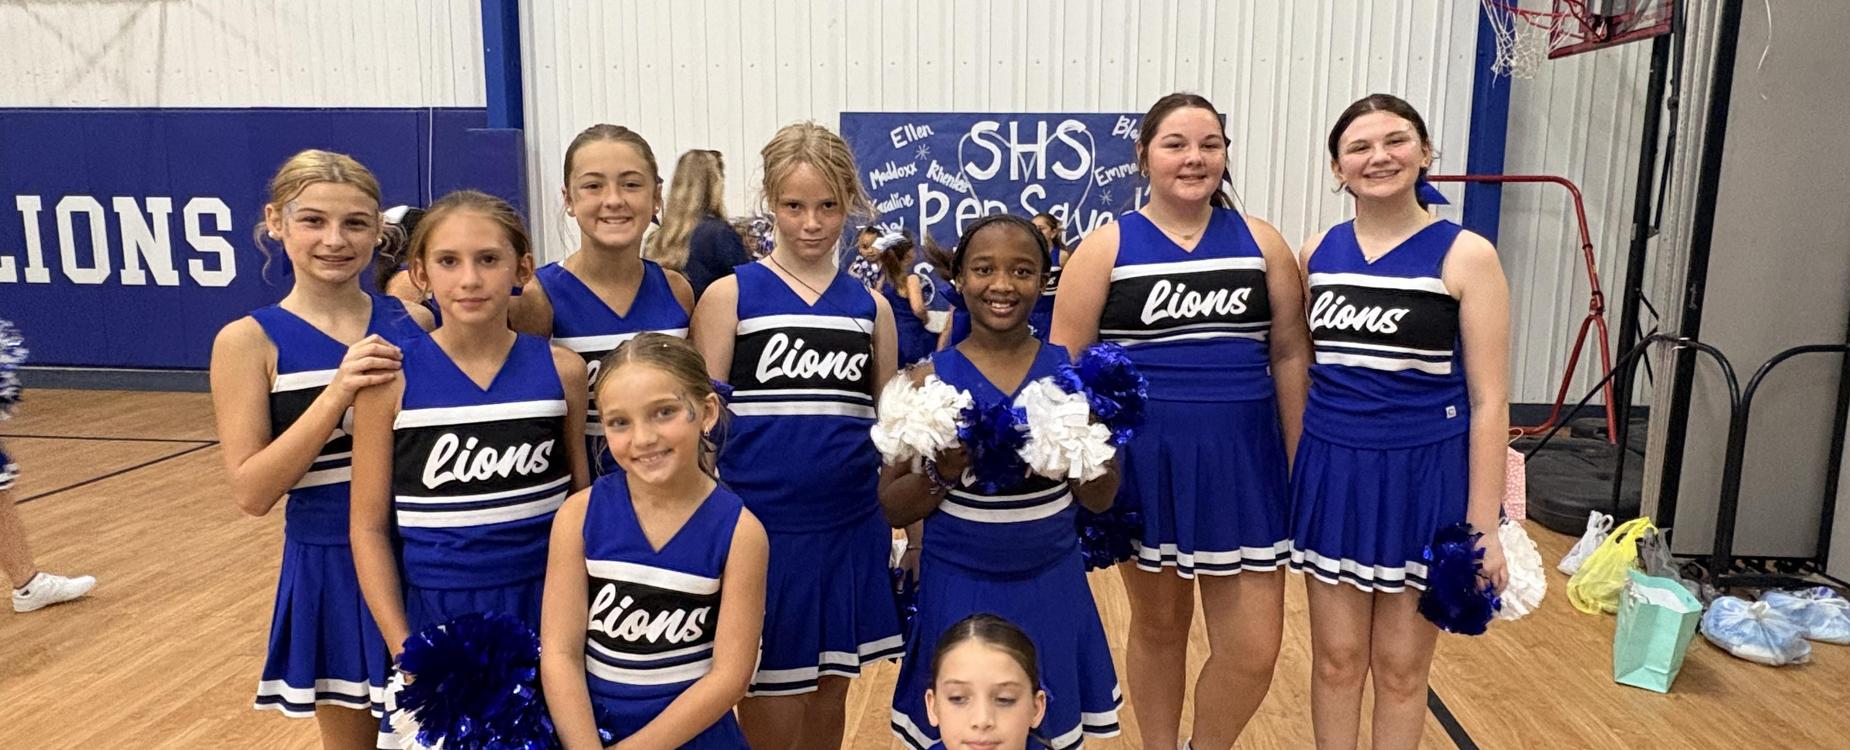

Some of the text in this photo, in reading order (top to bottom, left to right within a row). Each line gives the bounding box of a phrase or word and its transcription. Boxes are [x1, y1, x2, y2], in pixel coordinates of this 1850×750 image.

[890, 123, 934, 149] Ellen
[964, 119, 1092, 181] SHS
[869, 161, 918, 190] Maddoxx
[1140, 279, 1252, 325] Lions
[1310, 290, 1410, 334] Lions
[755, 332, 869, 384] Lions
[422, 432, 556, 490] Lions
[587, 582, 712, 644] Lions
